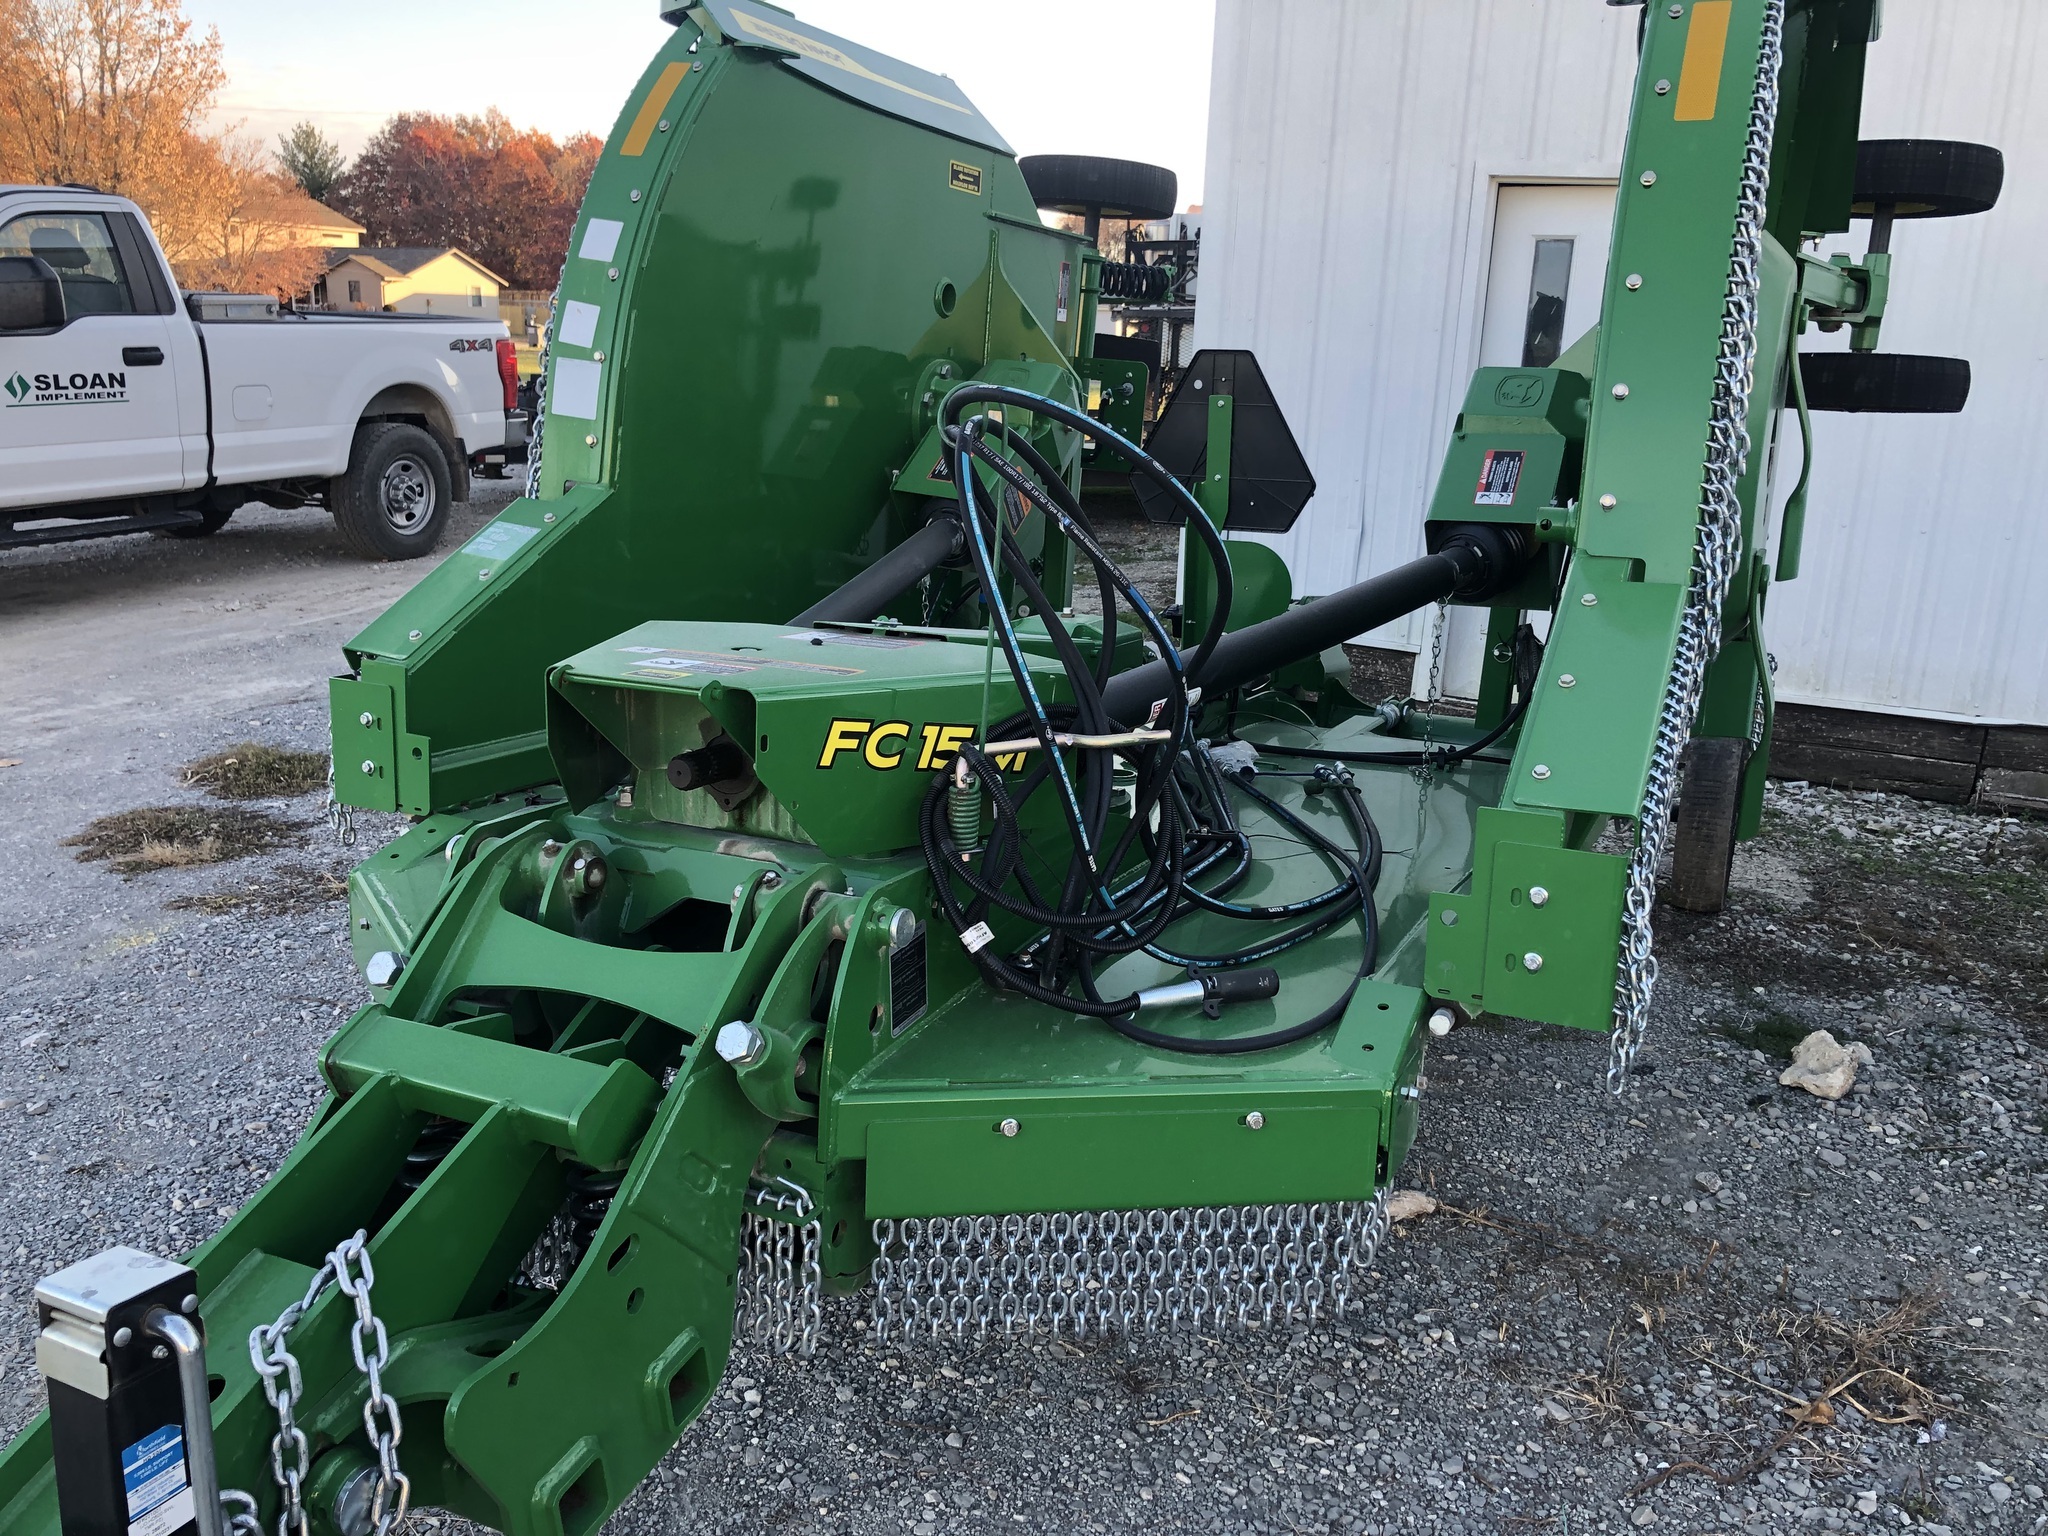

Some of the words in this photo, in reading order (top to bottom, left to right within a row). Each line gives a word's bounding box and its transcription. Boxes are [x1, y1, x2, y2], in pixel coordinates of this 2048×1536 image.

[34, 372, 126, 390] SLOAN
[36, 391, 126, 401] IMPLEMENT
[1481, 458, 1492, 478] DANGER
[992, 455, 1004, 466] SAE
[1029, 488, 1048, 504] 18752
[1044, 501, 1059, 514] Type
[1069, 523, 1085, 540] Flame
[1082, 537, 1104, 560] Resistant
[1101, 556, 1115, 571] MSHA
[817, 718, 912, 770] FC
[1088, 855, 1097, 872] GATES
[152, 1450, 173, 1466] SUPPORT
